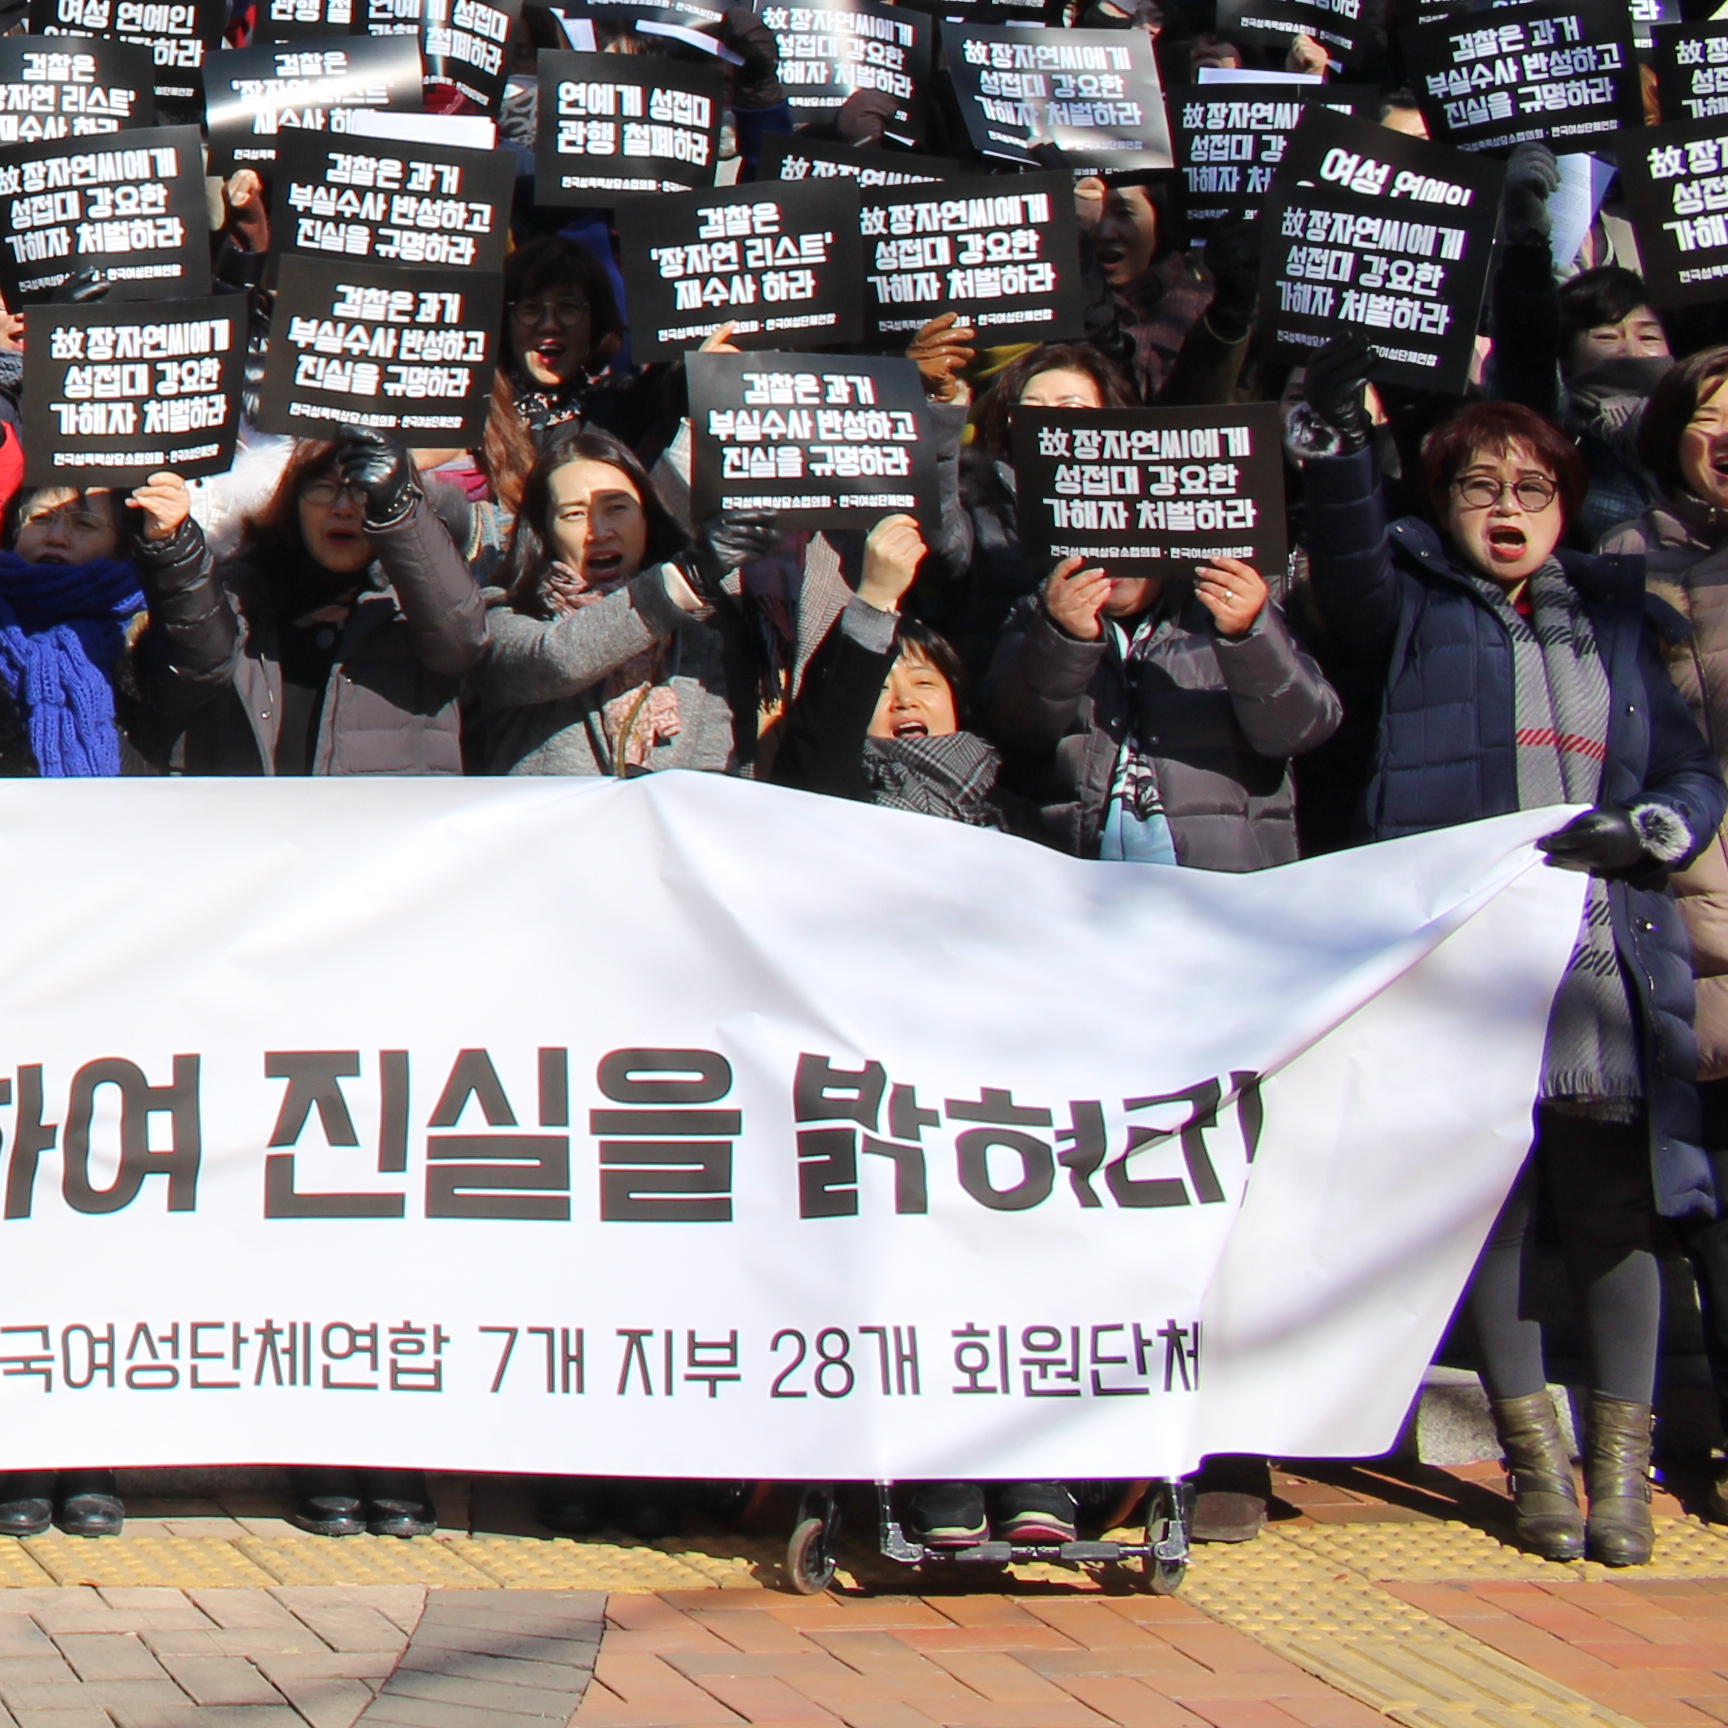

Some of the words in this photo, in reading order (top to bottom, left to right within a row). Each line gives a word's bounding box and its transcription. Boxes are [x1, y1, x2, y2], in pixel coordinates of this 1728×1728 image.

[1450, 25, 1524, 62] 검찰은
[1529, 16, 1579, 45] 과거
[1426, 57, 1518, 99] 부실수사
[1522, 43, 1621, 81] 반성하고
[1444, 92, 1512, 128] 진실을
[1518, 77, 1613, 113] 규명하라
[334, 285, 413, 322] 검찰은
[416, 293, 460, 323] 과거
[289, 317, 397, 361] 부실수사
[400, 329, 484, 361] 반성하고
[65, 364, 148, 398] 성접대
[157, 358, 220, 395] 강요한
[296, 355, 379, 395] 진실을
[384, 366, 470, 397] 규명하라
[744, 373, 819, 404] 검찰은
[823, 375, 874, 404] 과거
[51, 402, 137, 434] 가해자
[144, 394, 226, 433] 처벌하라
[710, 410, 813, 440] 부실수사
[817, 410, 917, 440] 반성하고
[723, 447, 803, 478] 진실을
[810, 445, 909, 476] 규명하라
[1055, 465, 1139, 495] 성접대
[1149, 463, 1238, 495] 강요한
[1043, 499, 1128, 529] 가해자
[1136, 499, 1256, 530] 처벌하라
[264, 1048, 742, 1222] 진실을
[479, 1327, 584, 1394] 7개
[617, 1329, 741, 1398] 지부
[771, 1326, 920, 1398] 28개
